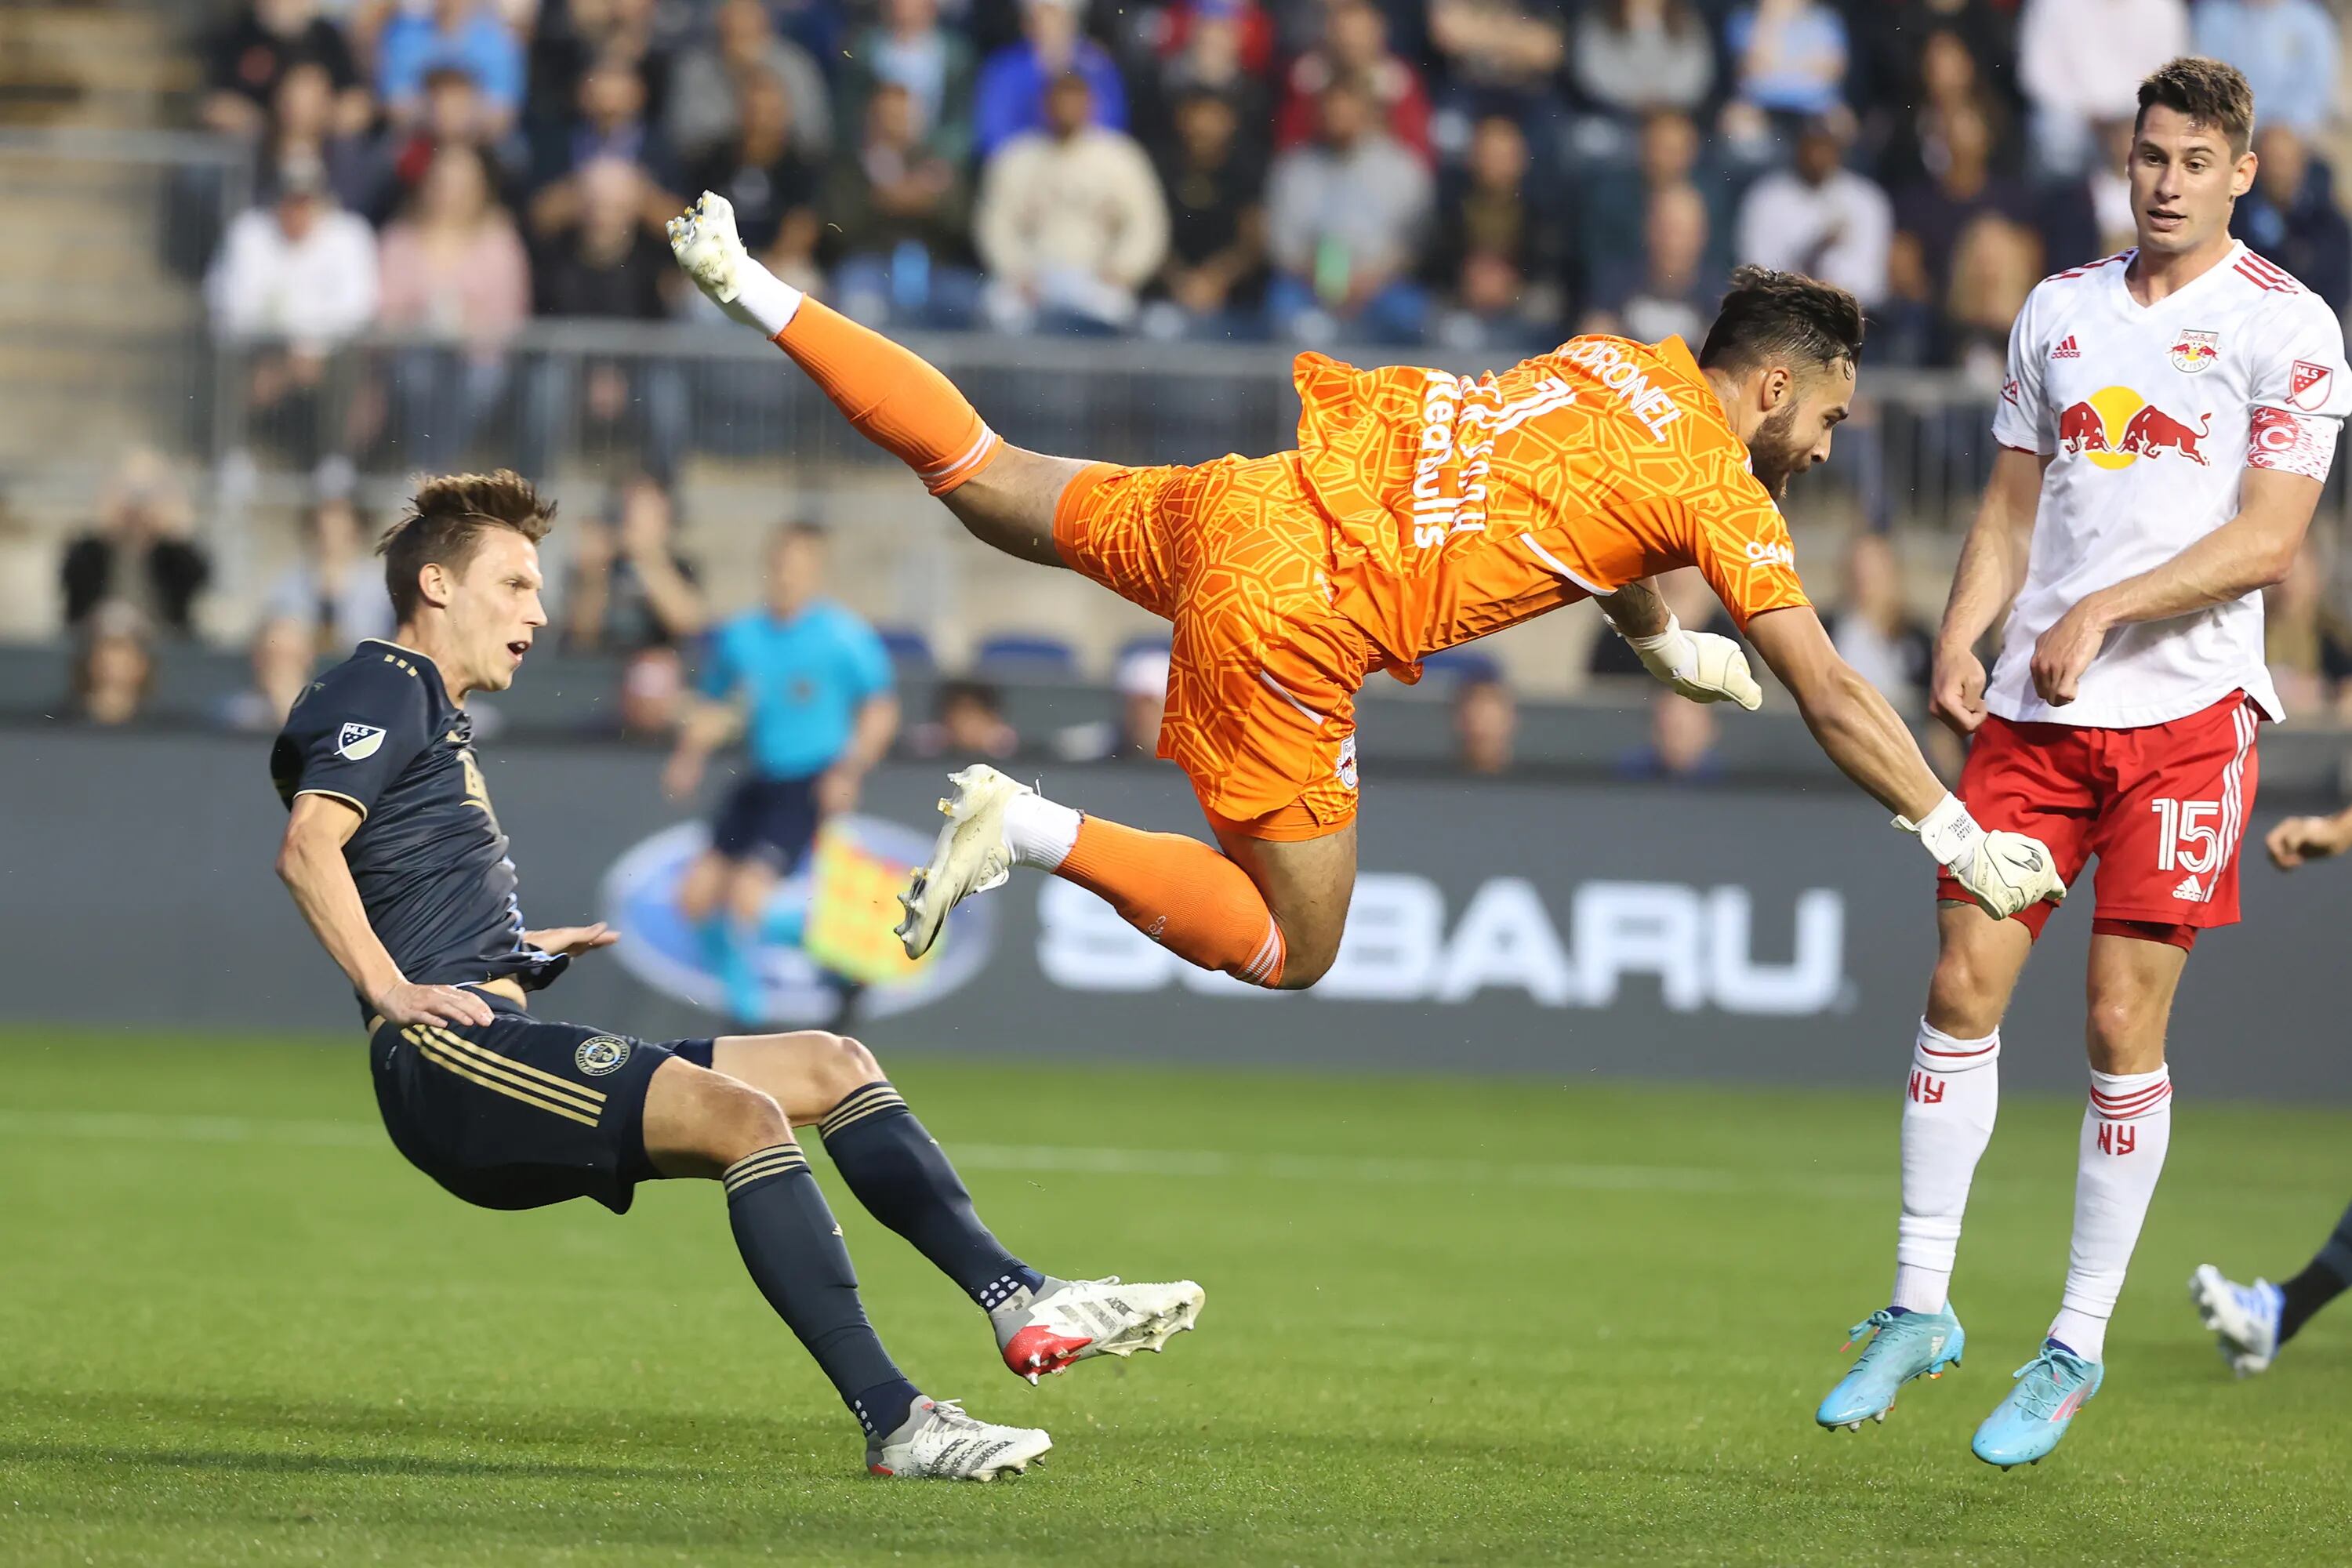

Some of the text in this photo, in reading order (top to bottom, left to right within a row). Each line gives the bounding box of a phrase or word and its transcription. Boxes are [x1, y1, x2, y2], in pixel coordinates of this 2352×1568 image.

[2296, 366, 2318, 379] MLS
[1496, 376, 1577, 435] 1
[2259, 426, 2296, 451] C
[345, 725, 368, 736] MLS
[2151, 797, 2218, 874] 15
[1038, 871, 1845, 1017] SBARU
[1907, 1069, 1946, 1104] NY
[2097, 1122, 2136, 1156] NY
